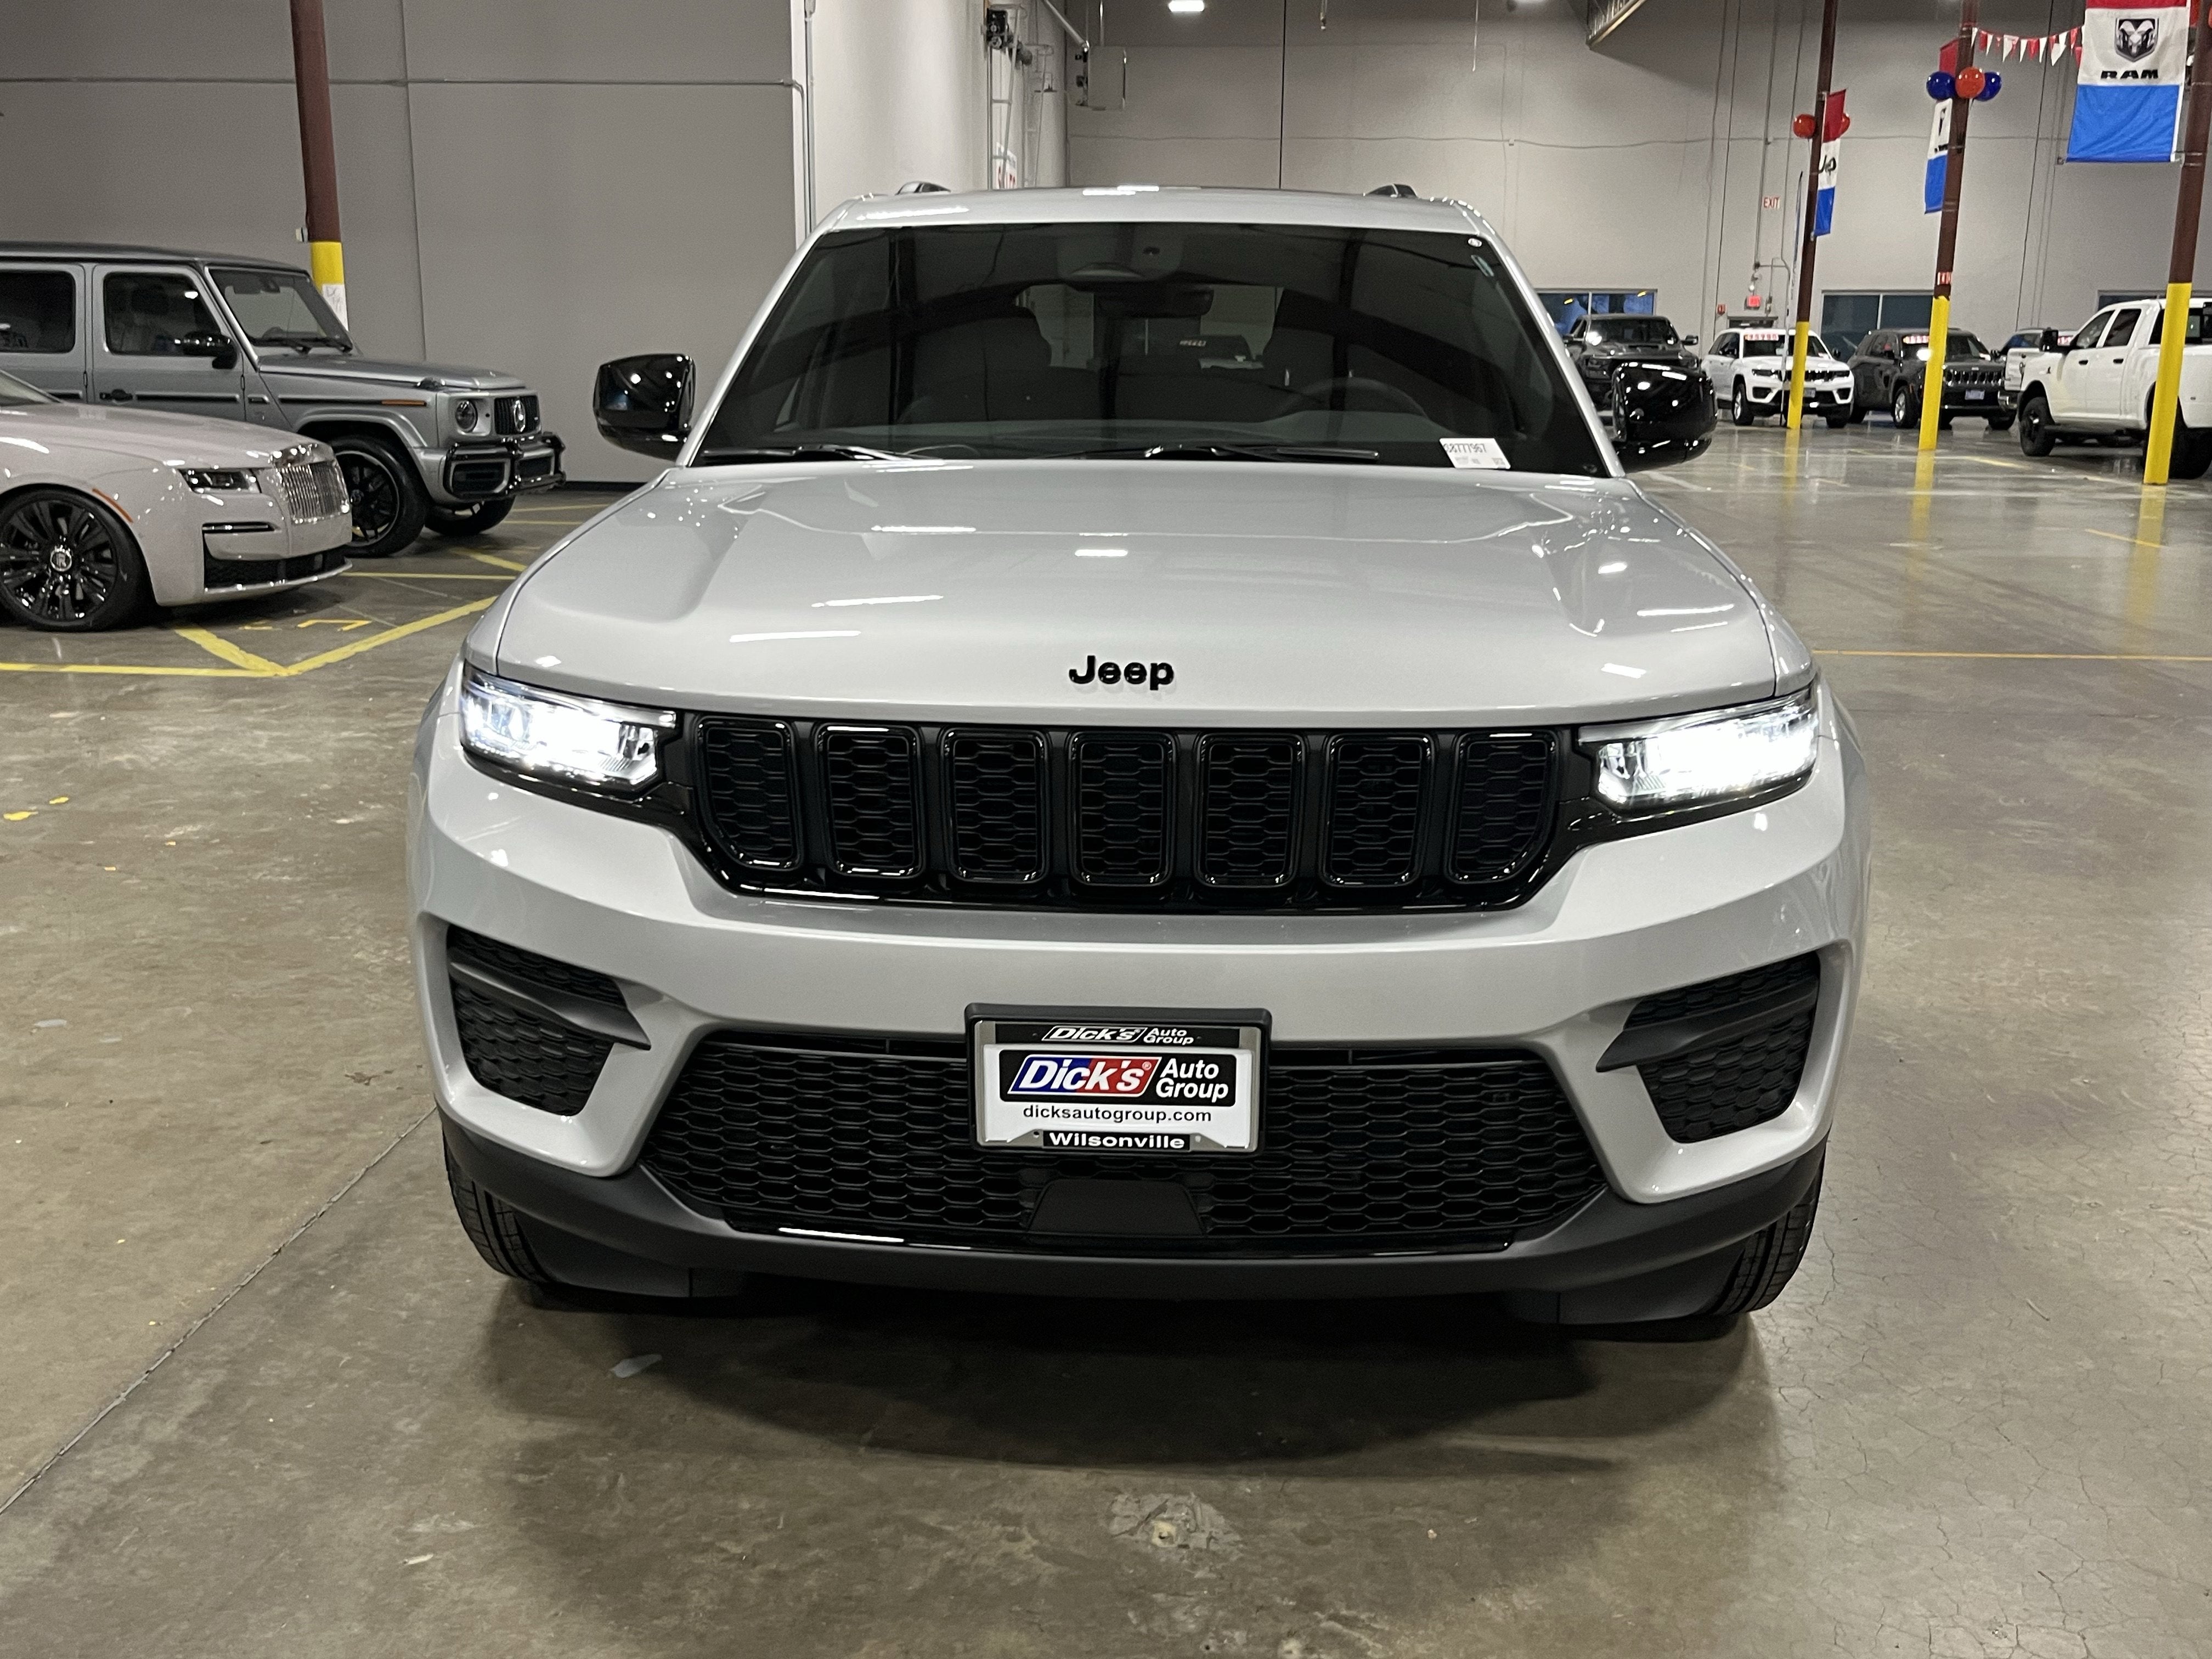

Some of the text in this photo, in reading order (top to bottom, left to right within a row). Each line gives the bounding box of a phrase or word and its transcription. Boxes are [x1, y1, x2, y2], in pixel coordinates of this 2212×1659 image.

[2100, 69, 2159, 80] RAM
[1763, 196, 1780, 208] EXIT
[1068, 655, 1175, 691] Jeep
[1049, 1027, 1187, 1041] Dick's Auto
[1143, 1035, 1194, 1046] Group
[1018, 1057, 1220, 1091] Dick's Auto
[1155, 1079, 1229, 1103] Group
[1023, 1105, 1212, 1123] dicksautogroup.com
[1049, 1132, 1185, 1149] Wilsonville
